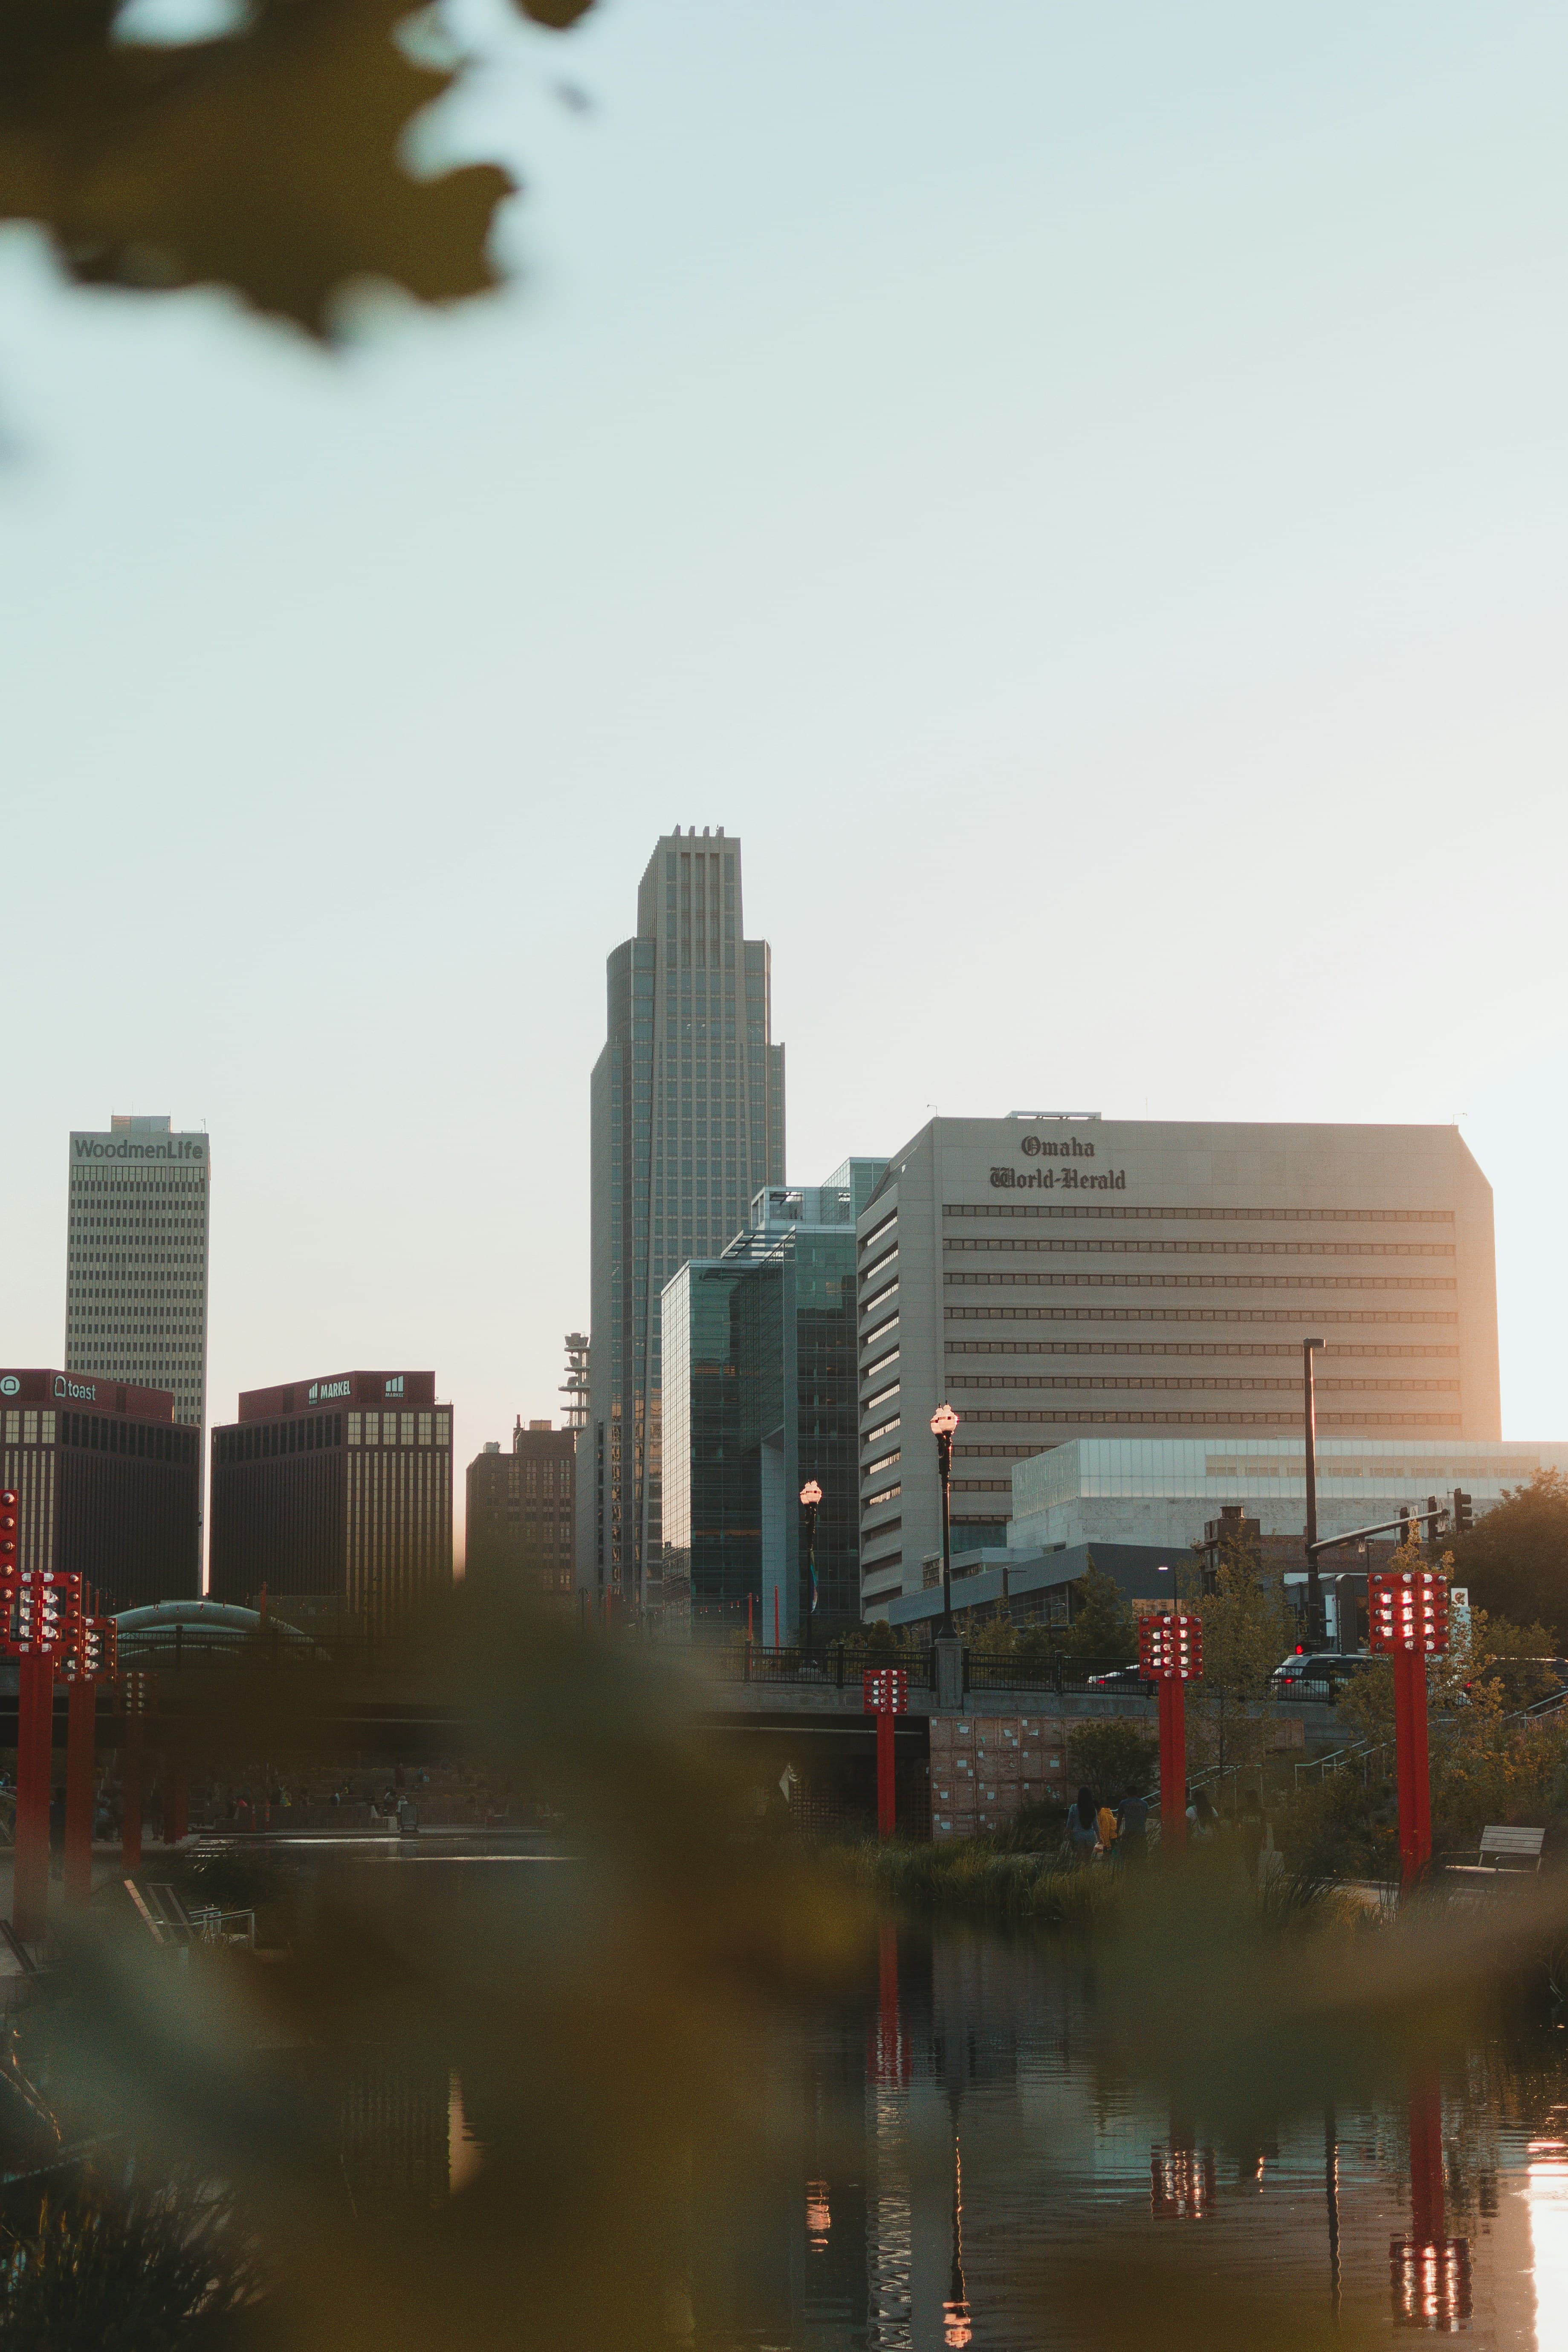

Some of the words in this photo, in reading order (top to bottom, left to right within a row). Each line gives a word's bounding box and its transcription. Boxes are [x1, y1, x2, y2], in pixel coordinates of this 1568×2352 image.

[75, 1139, 203, 1159] WoodmenLife
[1021, 1135, 1095, 1157] Omaha
[989, 1166, 1126, 1190] World-Herald
[68, 1380, 96, 1401] toast
[320, 1380, 351, 1400] MARKEL
